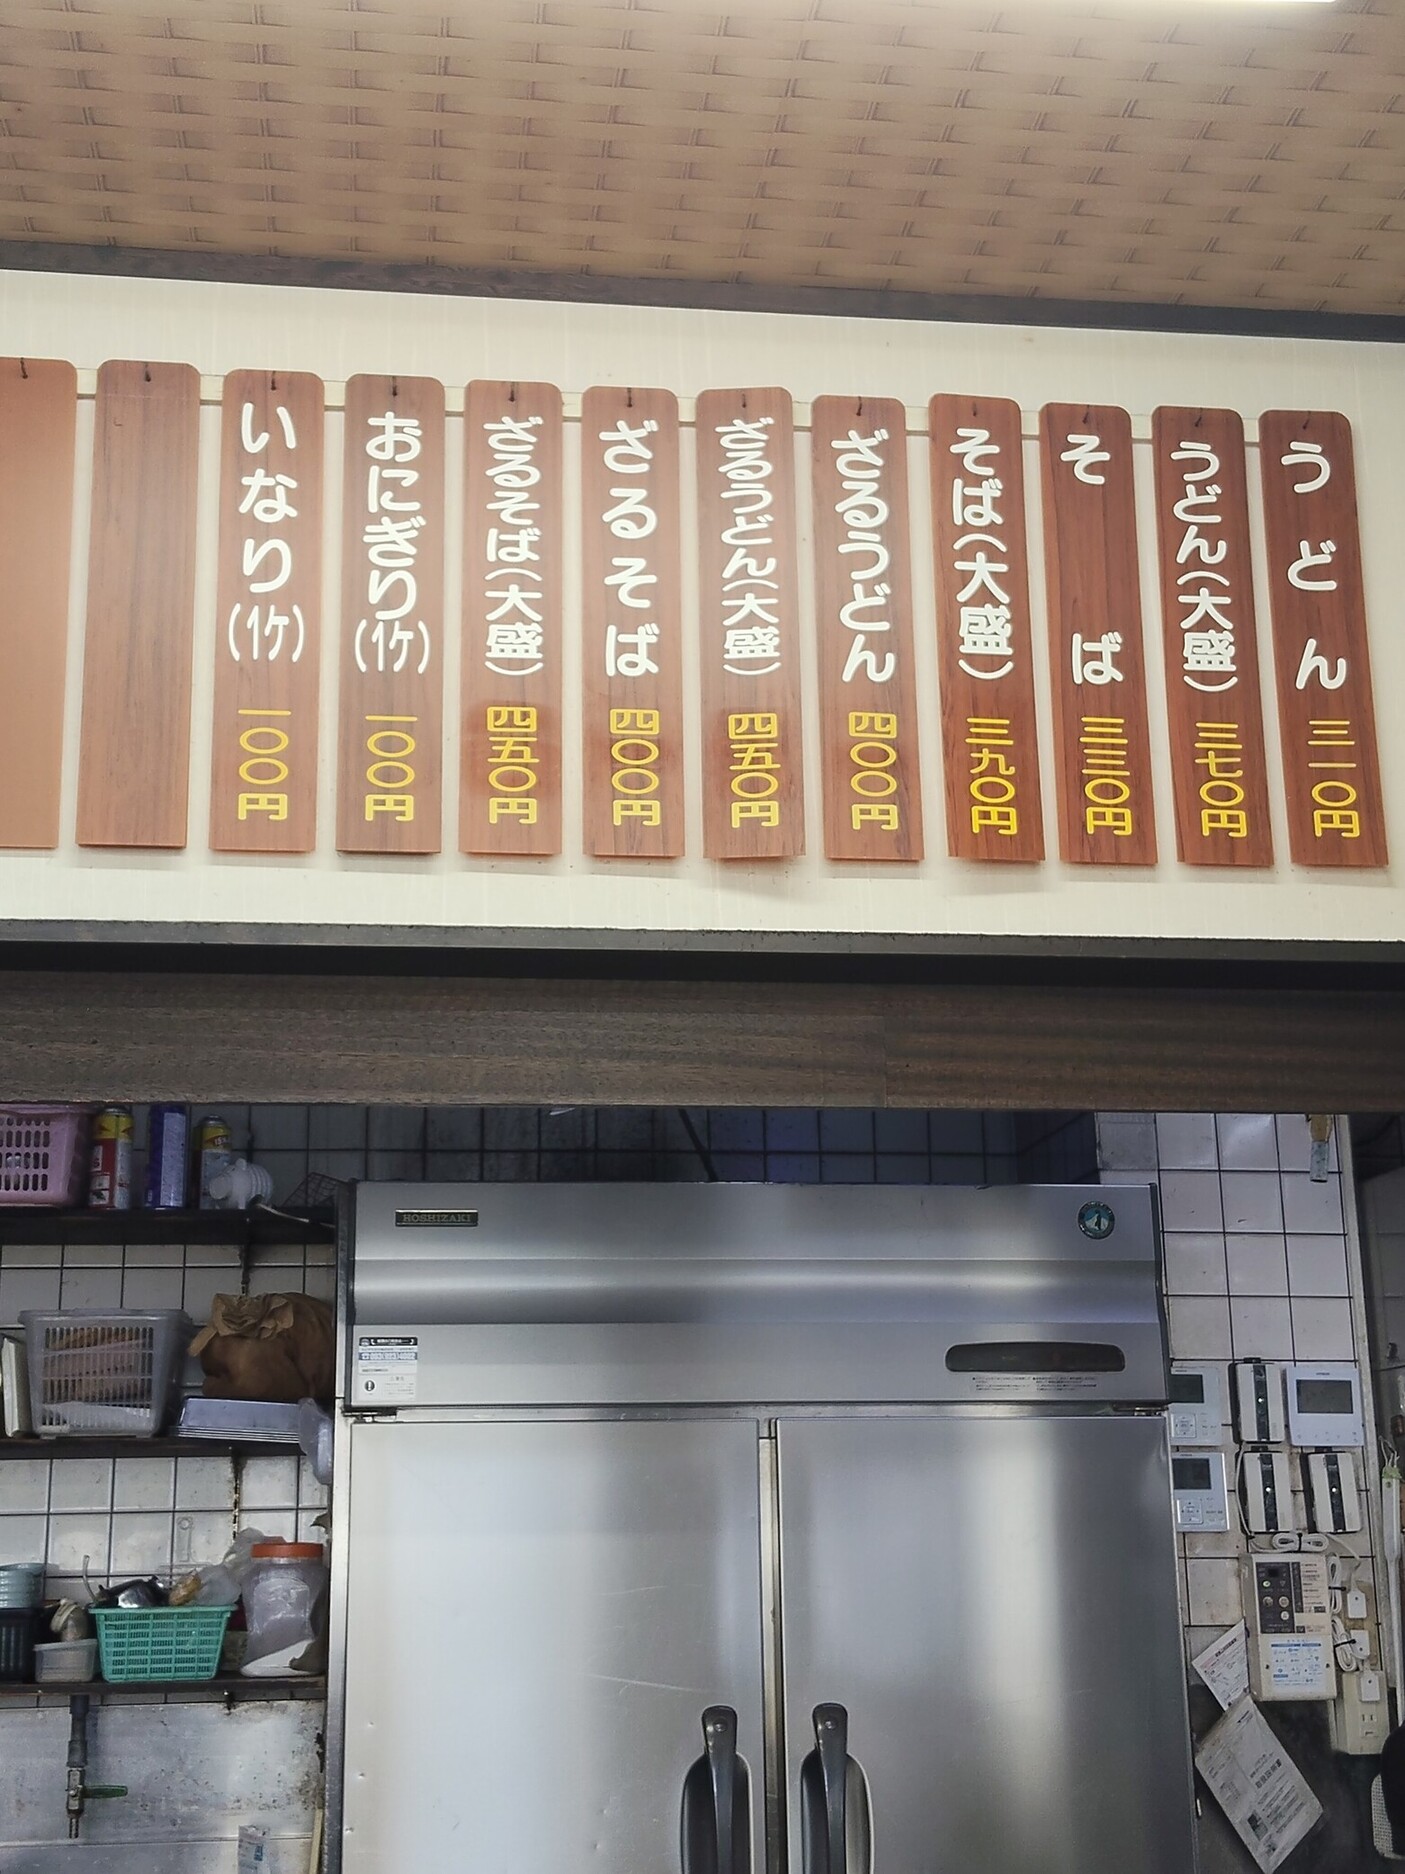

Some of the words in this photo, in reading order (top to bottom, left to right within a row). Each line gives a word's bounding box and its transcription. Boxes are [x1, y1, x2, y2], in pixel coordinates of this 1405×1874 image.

[484, 415, 544, 677] ざるそば(大盛)
[598, 419, 660, 678] ざるそば
[715, 416, 783, 676] ざるうどん(大盛)
[831, 428, 896, 683] ざるうどん
[949, 428, 1014, 680] そば(大盛)
[1060, 434, 1123, 685] そば
[1170, 441, 1238, 693] うどん(大盛)
[1281, 441, 1347, 690] うどん
[402, 1213, 471, 1223] HOSHIZAKI
